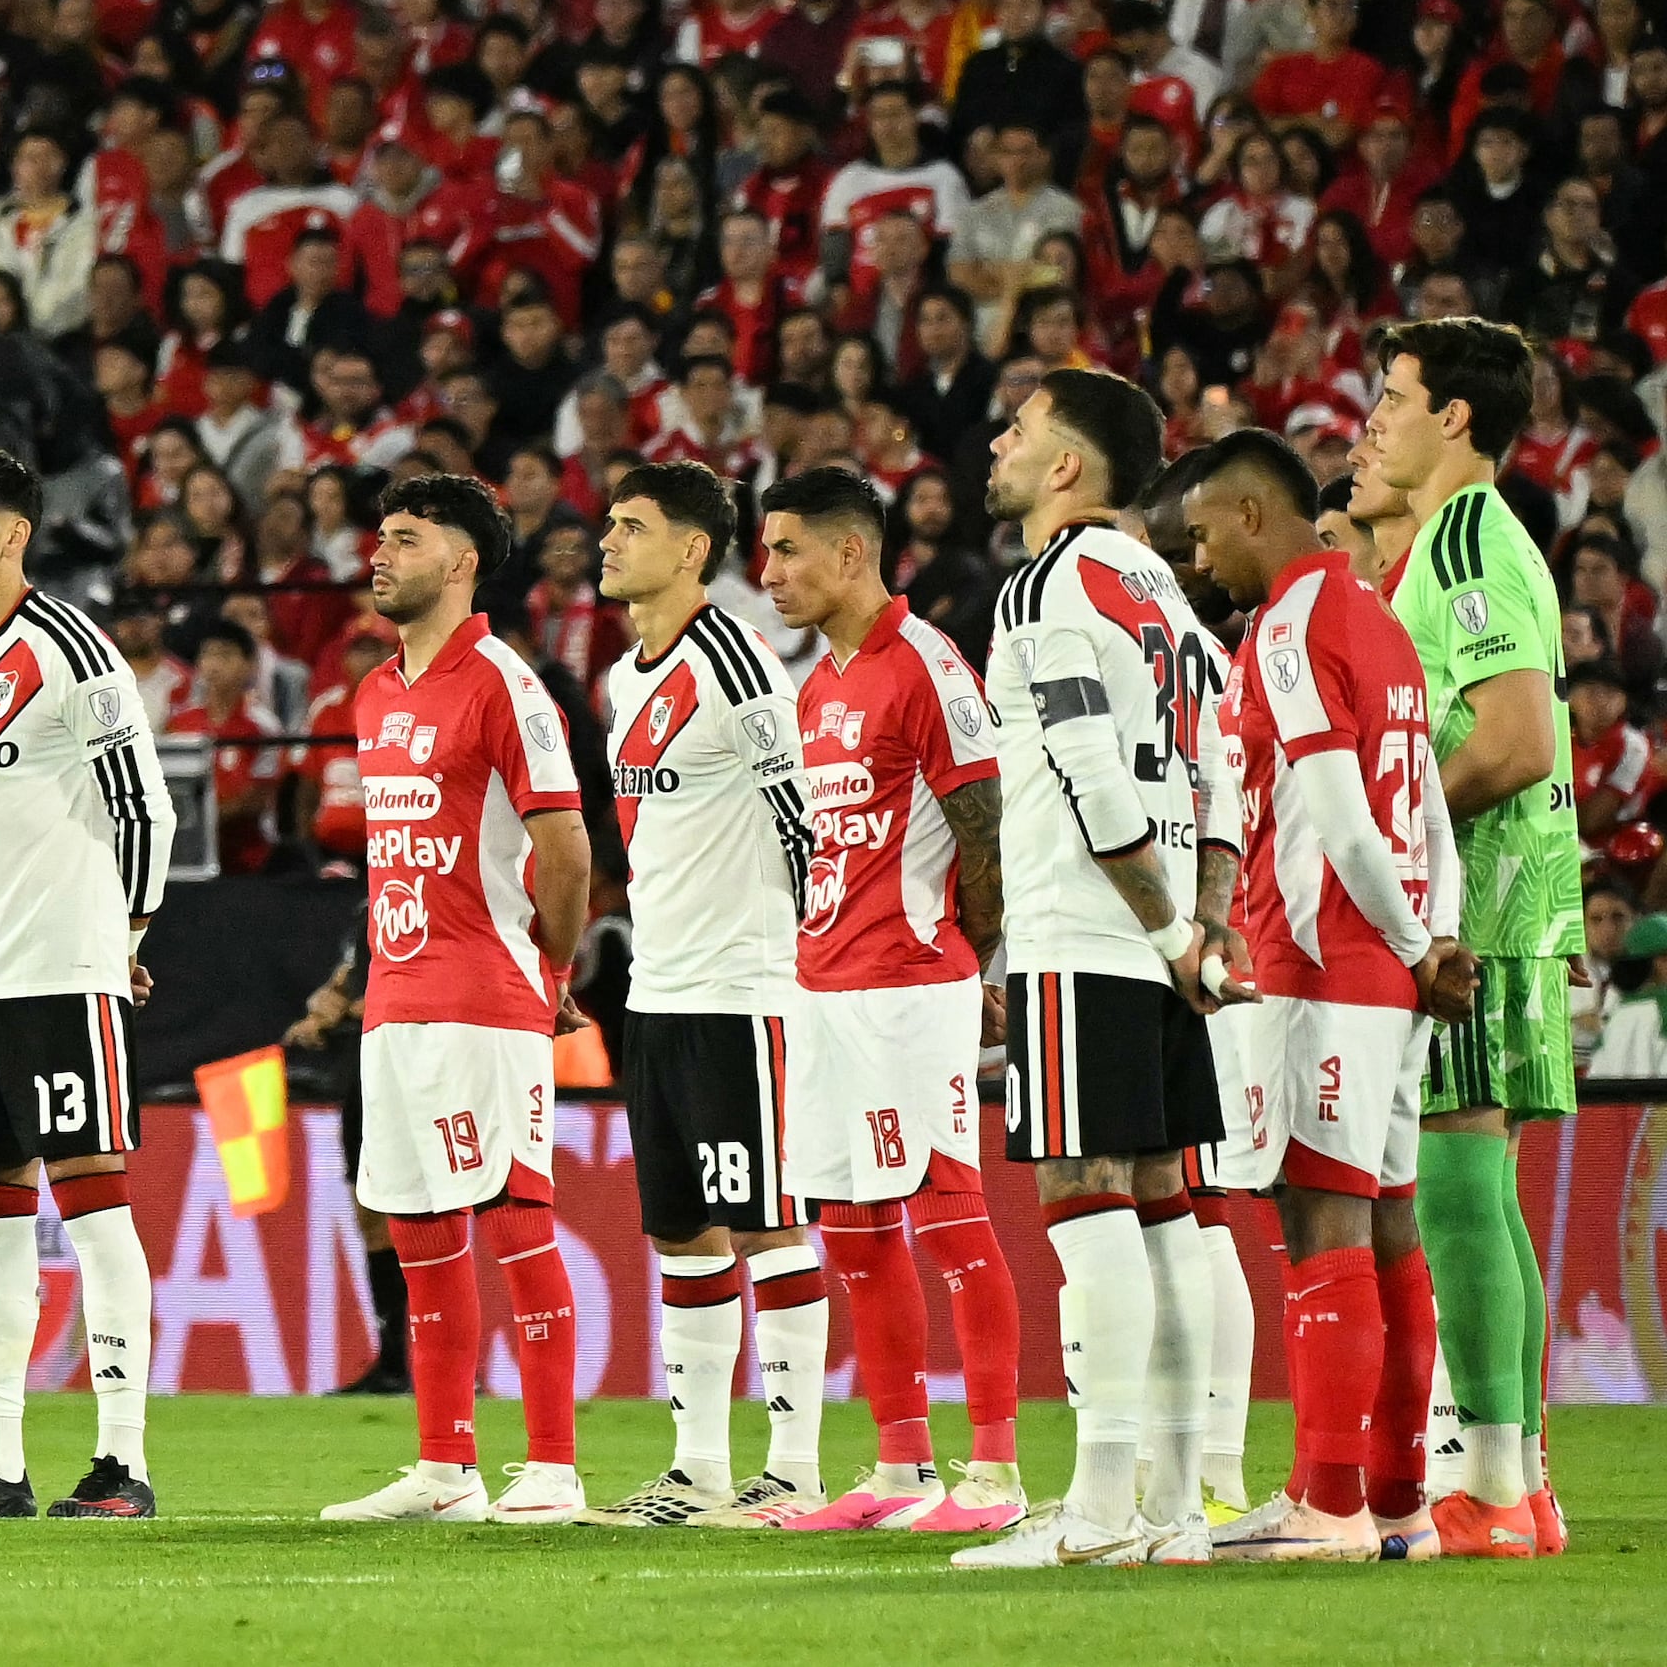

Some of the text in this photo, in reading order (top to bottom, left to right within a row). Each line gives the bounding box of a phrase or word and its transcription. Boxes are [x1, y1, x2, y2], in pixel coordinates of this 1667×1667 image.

[1456, 633, 1510, 657] ASSIST
[1474, 642, 1516, 661] CARD
[87, 725, 133, 748] ASSIST
[1134, 623, 1207, 791] 30
[613, 763, 681, 795] etano
[762, 761, 794, 777] CARD
[34, 1071, 87, 1134] 13
[529, 1084, 543, 1143] FILA
[949, 1073, 967, 1133] FILA
[1319, 1055, 1341, 1122] FILA
[433, 1110, 483, 1174] 19
[866, 1108, 906, 1168] 18
[698, 1141, 750, 1203] 28
[92, 1334, 127, 1349] RIVER
[423, 1311, 442, 1322] FE
